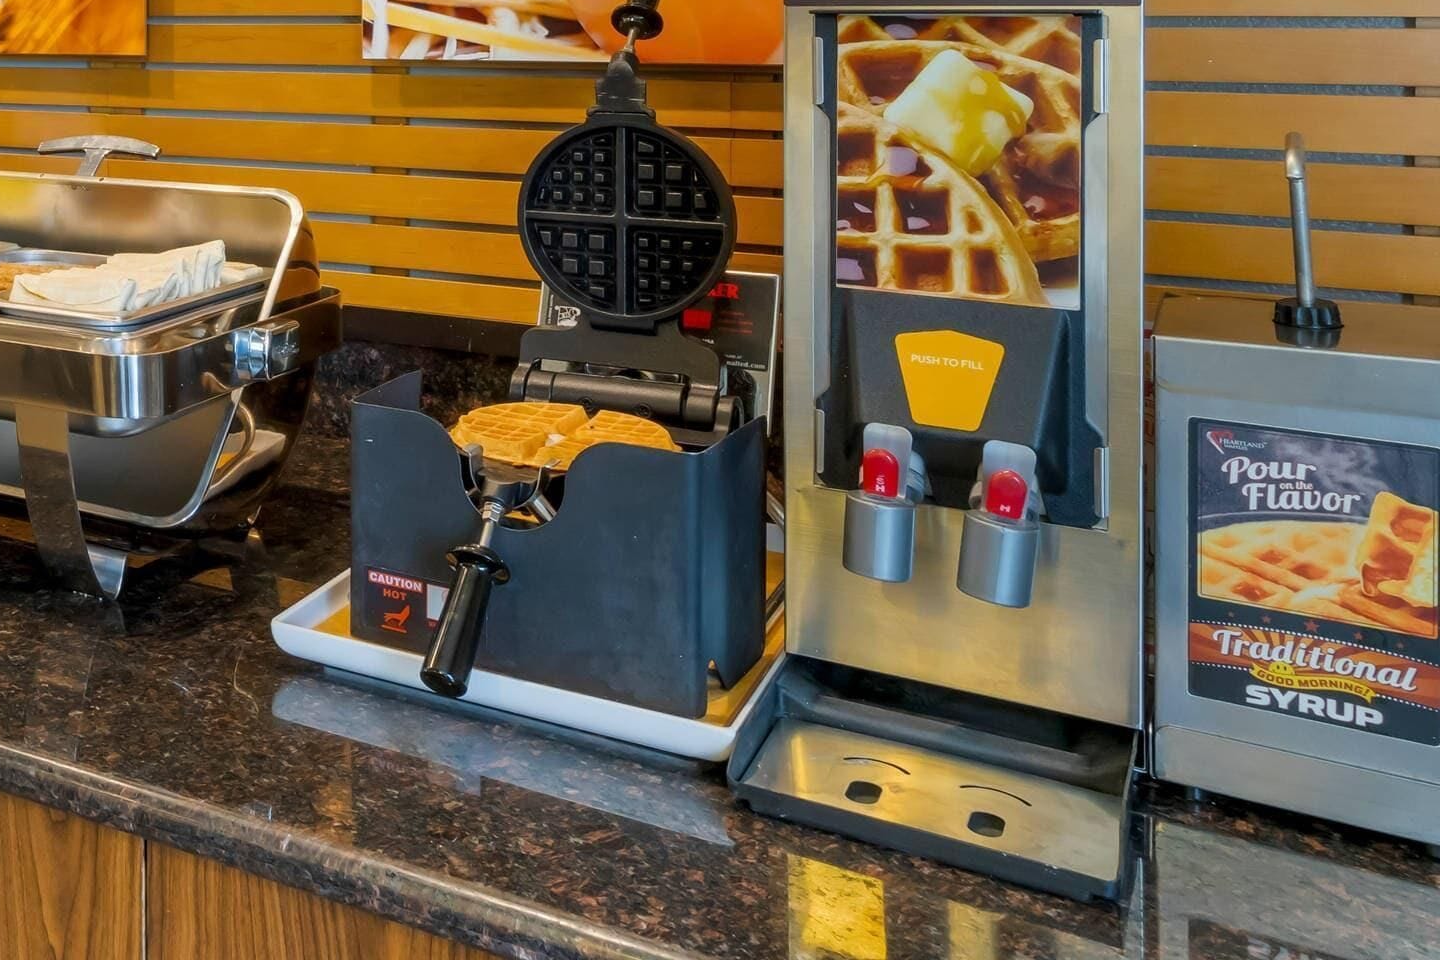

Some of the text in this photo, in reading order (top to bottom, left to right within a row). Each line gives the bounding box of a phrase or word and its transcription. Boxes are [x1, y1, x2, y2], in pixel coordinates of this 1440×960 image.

[910, 353, 985, 371] PUSH TO FILL
[1221, 456, 1317, 484] Pour
[1241, 482, 1361, 514] Flavor
[1279, 481, 1313, 491] on the
[368, 571, 423, 591] CAUTION
[383, 588, 408, 601] HOT
[1212, 629, 1417, 691] Traditional
[1257, 669, 1371, 697] GOOD MORNING!
[1245, 684, 1384, 727] SYRUP
